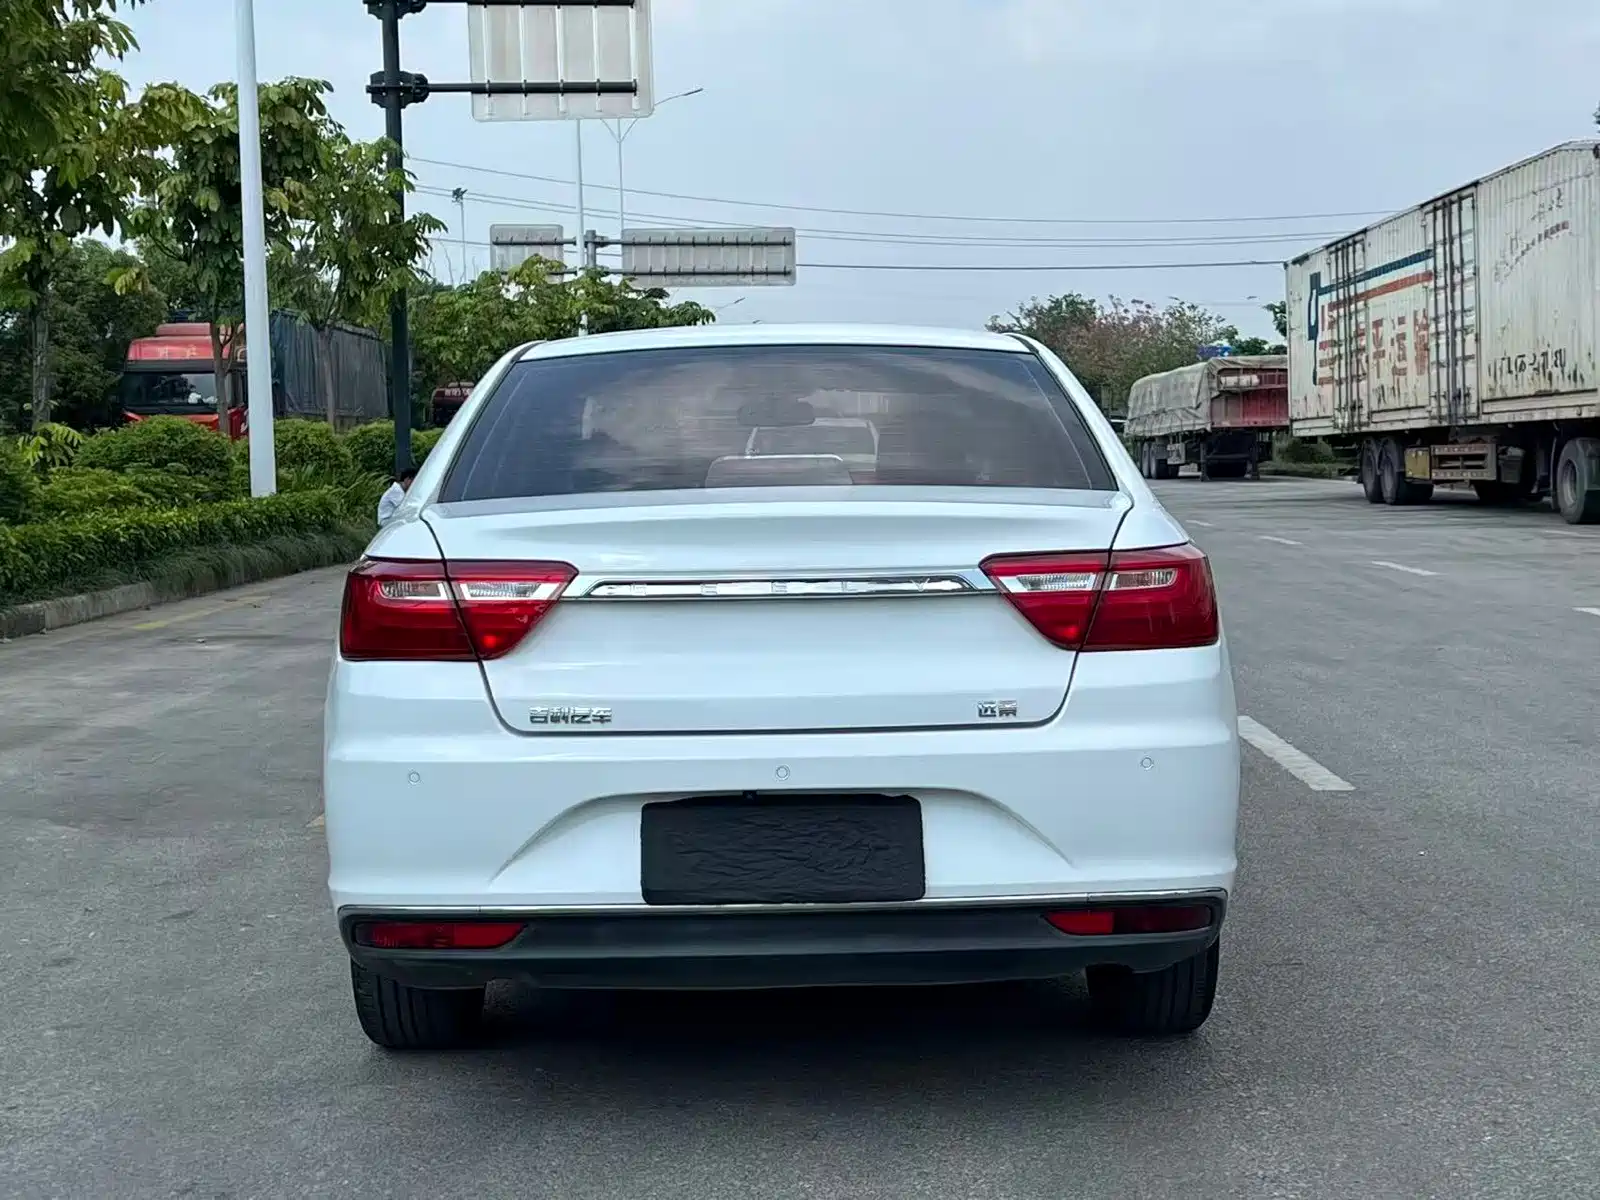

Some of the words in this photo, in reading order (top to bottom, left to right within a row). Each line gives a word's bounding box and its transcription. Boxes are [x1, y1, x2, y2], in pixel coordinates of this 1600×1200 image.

[630, 577, 931, 597] GEELY
[529, 706, 612, 724] 吉利汽车
[977, 699, 1018, 718] 远景
